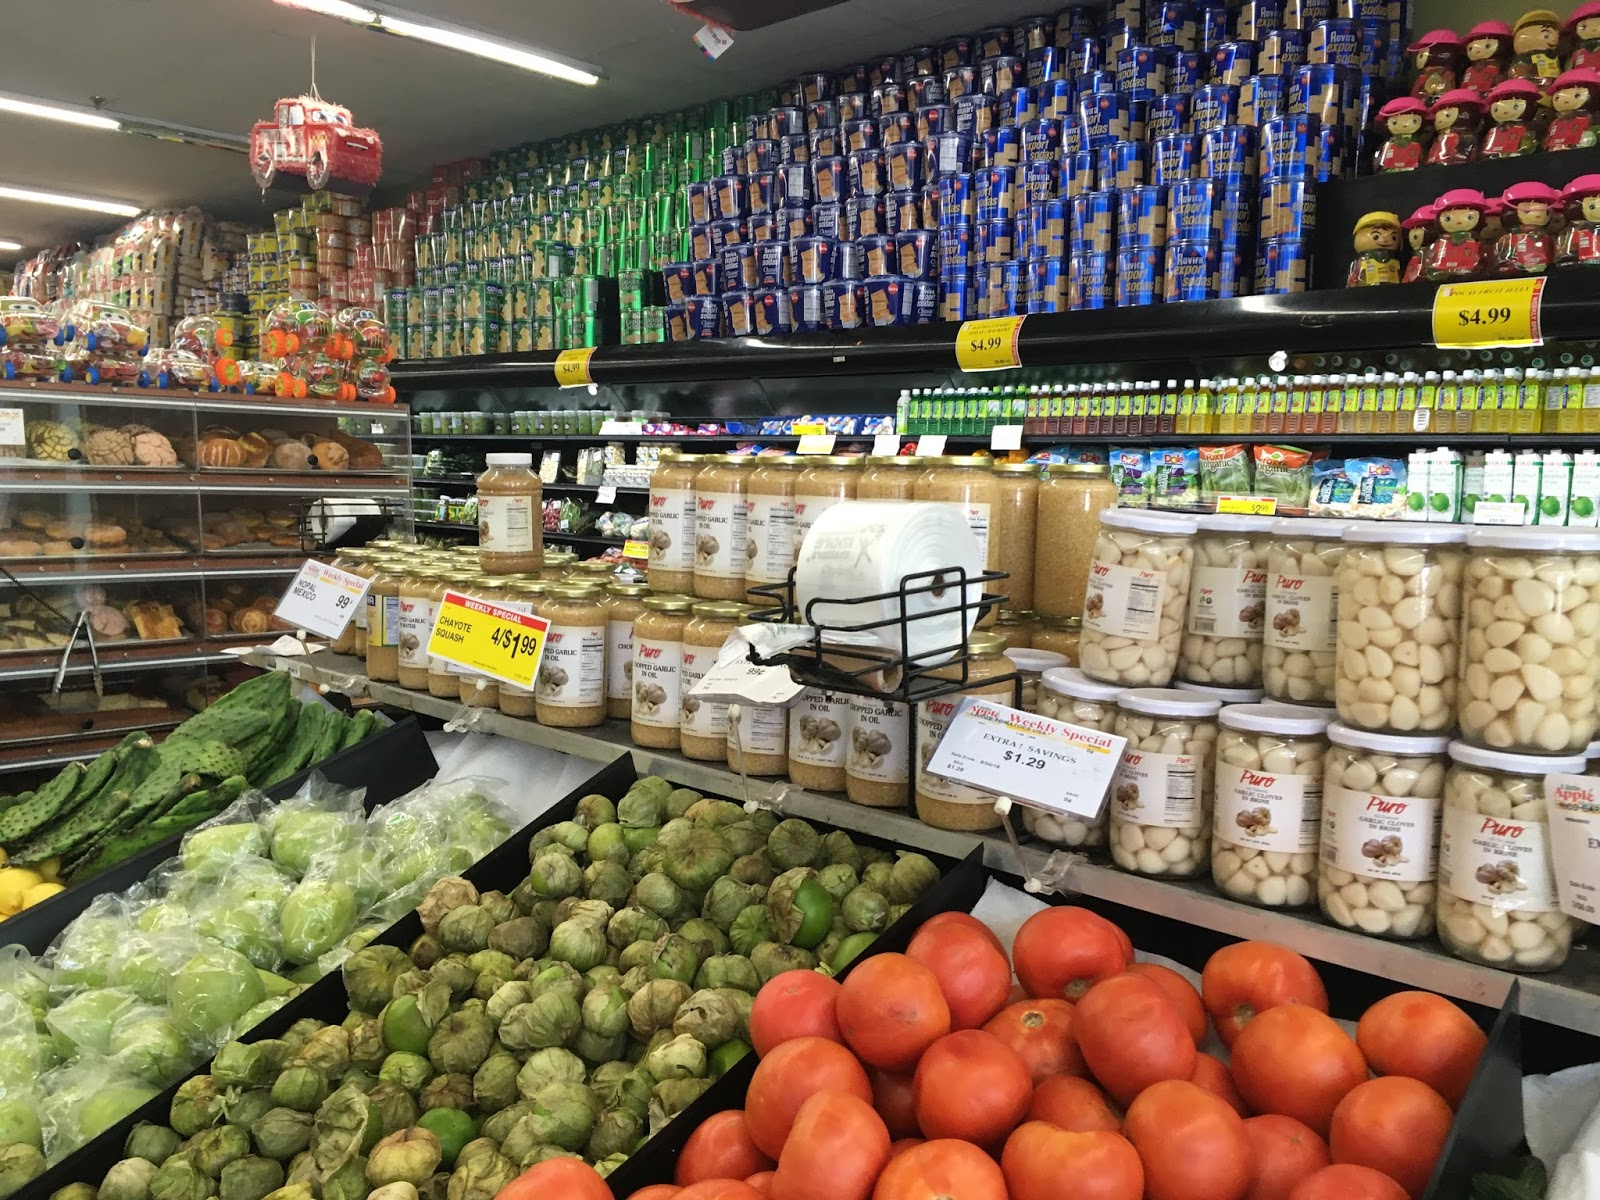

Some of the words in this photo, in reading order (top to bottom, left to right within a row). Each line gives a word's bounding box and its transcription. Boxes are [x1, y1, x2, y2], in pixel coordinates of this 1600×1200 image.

[1330, 31, 1355, 43] Rovira
[1326, 42, 1357, 54] export
[1177, 253, 1205, 265] Rovira
[1173, 264, 1207, 276] export
[1458, 307, 1511, 326] $4.99
[970, 337, 1002, 352] $4.99
[562, 363, 580, 374] $4.99
[1080, 453, 1101, 462] Dole
[1121, 454, 1139, 464] Dole
[1164, 454, 1184, 463] Dole
[1206, 453, 1225, 461] FOXY
[1203, 459, 1232, 470] organic
[1368, 464, 1392, 476] Dole
[651, 494, 668, 506] Puro
[698, 496, 717, 510] Puro
[323, 569, 342, 582] Weekly
[344, 576, 365, 590] Special
[1139, 570, 1155, 578] Puro
[297, 579, 317, 593] NOPAL
[1276, 574, 1304, 590] Puro
[292, 586, 317, 602] MEXICO
[464, 599, 492, 614] WEEKLY
[492, 609, 522, 624] SPECIAL
[439, 616, 472, 633] CHAYOTE
[435, 628, 465, 644] SQUASH
[639, 643, 662, 658] Puro
[648, 671, 657, 679] OIL
[653, 665, 677, 673] GARLIC
[746, 667, 766, 676] 99¢
[809, 703, 816, 711] IN
[818, 704, 830, 712] OIL
[925, 698, 955, 716] Puro
[860, 714, 868, 722] IN
[869, 716, 880, 724] OIL
[930, 730, 936, 738] IN
[1009, 713, 1058, 735] Weekly
[1062, 727, 1112, 748] Special
[1032, 728, 1047, 736] USA
[1003, 750, 1046, 770] $1.29
[1027, 745, 1077, 764] SAVINGS
[947, 763, 965, 773] $1.29
[1240, 769, 1277, 788] Puro
[1234, 788, 1256, 798] GARLIC
[1257, 792, 1283, 801] CLOVES
[1555, 787, 1595, 802] Apple
[1250, 797, 1270, 805] BRINE
[1366, 796, 1408, 815] Puro
[1359, 816, 1384, 825] GARLIC
[1386, 819, 1415, 828] CLOVES
[1368, 823, 1377, 831] IN
[1379, 824, 1402, 833] BRINE
[1480, 817, 1526, 838] Puro
[1473, 838, 1500, 847] GARLIC
[1493, 848, 1518, 858] BRINE
